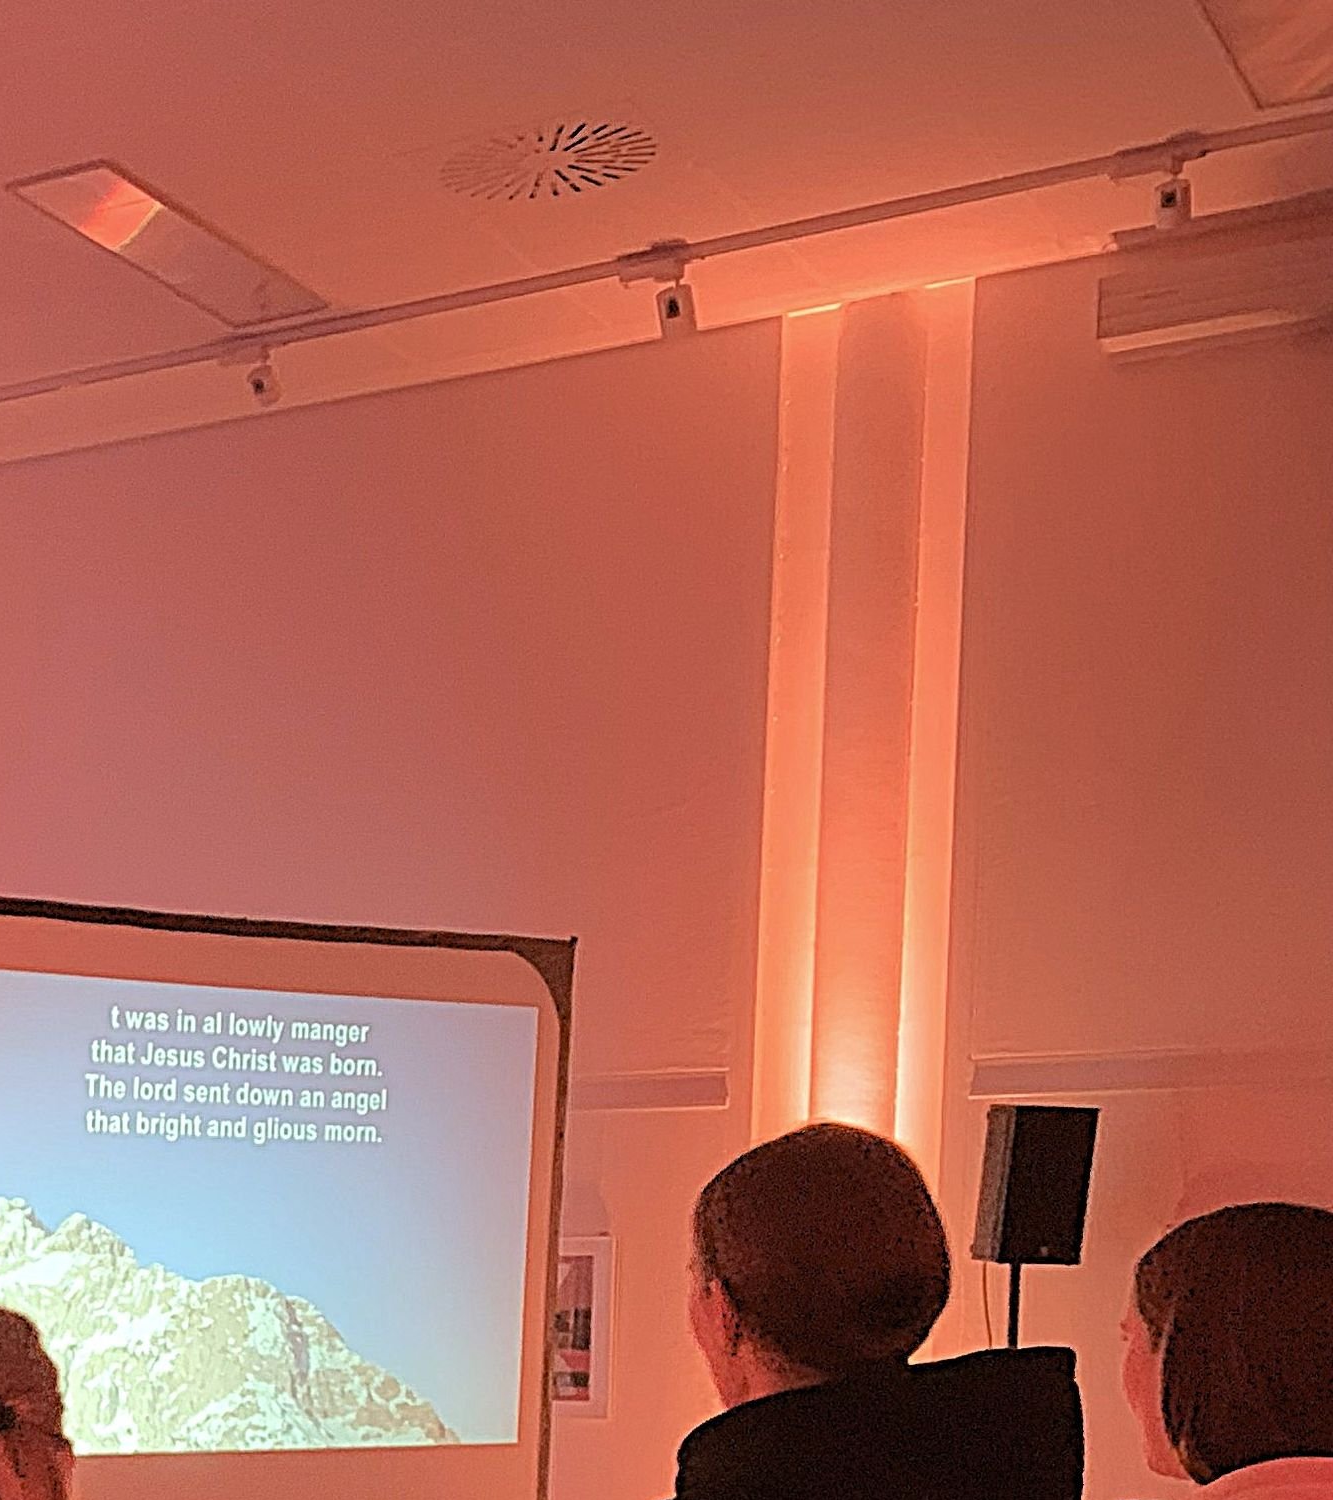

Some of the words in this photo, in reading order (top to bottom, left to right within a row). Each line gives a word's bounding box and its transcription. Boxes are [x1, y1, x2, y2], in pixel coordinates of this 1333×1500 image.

[110, 1005, 121, 1030] t
[125, 1010, 169, 1031] was
[176, 1008, 196, 1035] in
[202, 1011, 222, 1035] al
[228, 1012, 285, 1044] lowly
[291, 1022, 370, 1048] manger
[91, 1039, 136, 1065] that
[140, 1042, 206, 1068] Jesus
[212, 1045, 277, 1072] Christ
[281, 1055, 323, 1075] was
[329, 1052, 383, 1077] born.
[85, 1073, 126, 1099] The
[133, 1076, 177, 1101] lord
[183, 1082, 231, 1105] sent
[236, 1082, 294, 1107] down
[299, 1090, 325, 1108] an
[331, 1088, 387, 1116] angel
[86, 1109, 130, 1135] that
[136, 1111, 202, 1142] bright
[206, 1116, 247, 1138] and
[253, 1116, 318, 1145] glious
[324, 1124, 382, 1143] morn.
